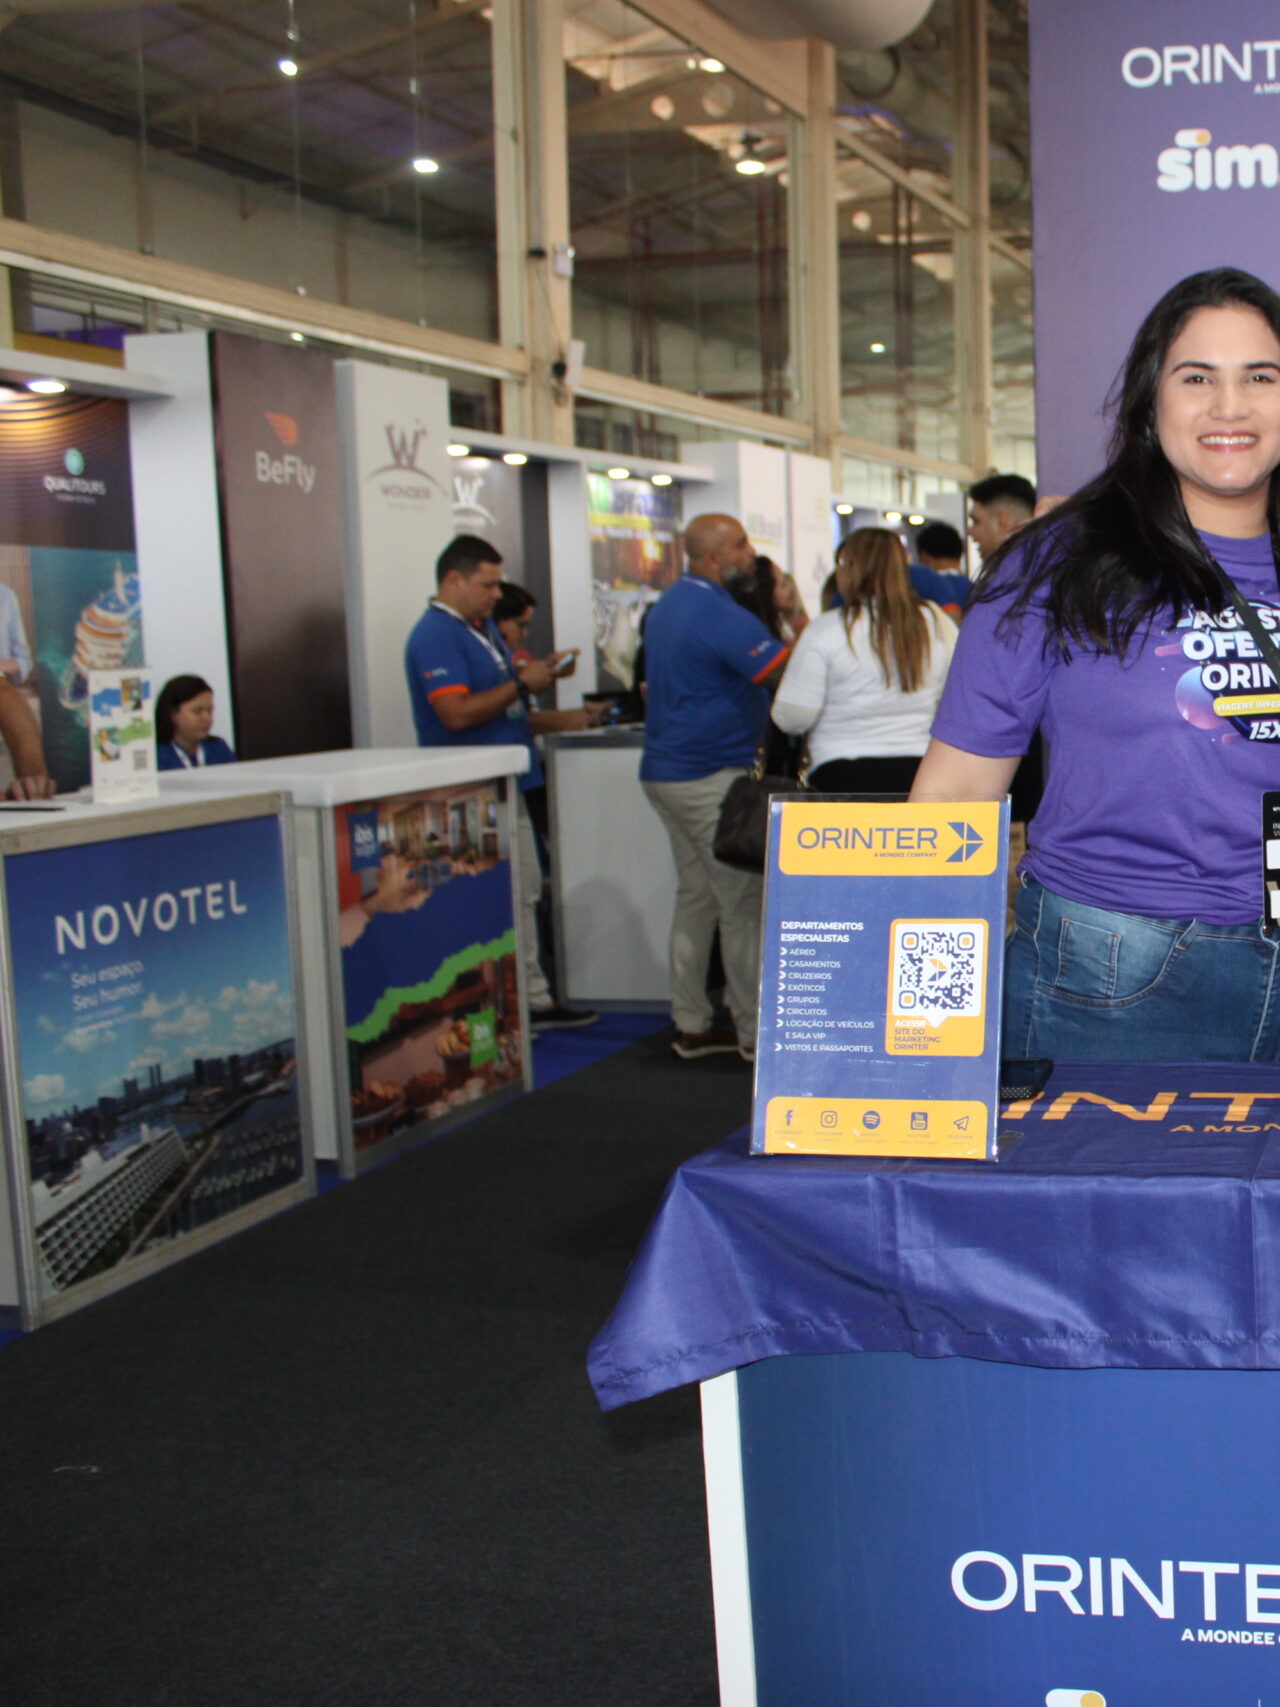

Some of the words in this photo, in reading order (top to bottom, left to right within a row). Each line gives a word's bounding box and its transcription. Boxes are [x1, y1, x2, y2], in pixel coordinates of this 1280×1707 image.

[1254, 83, 1262, 94] A
[255, 449, 315, 493] BeFly
[797, 827, 937, 849] ORINTER
[54, 880, 247, 955] NOVOTEL
[781, 921, 864, 931] DEPARTAMENTOS
[780, 933, 850, 943] ESPECIALISTAS
[789, 947, 816, 956] AÉREO
[788, 960, 841, 968] CASAMENTOS
[788, 972, 832, 980] CRUZEIROS
[787, 983, 826, 992] EXÓTICOS
[787, 996, 820, 1004] GRUPOS
[786, 1008, 827, 1016] CIRCUITOS
[786, 1019, 823, 1028] LOCAÇÃO
[837, 1020, 875, 1029] VEÍCULOS
[785, 1043, 811, 1051] VISTOS
[819, 1045, 874, 1053] PASSAPORTES
[1170, 1124, 1195, 1133] A
[1181, 1629, 1195, 1641] A
[1198, 1630, 1276, 1646] MONDEE
